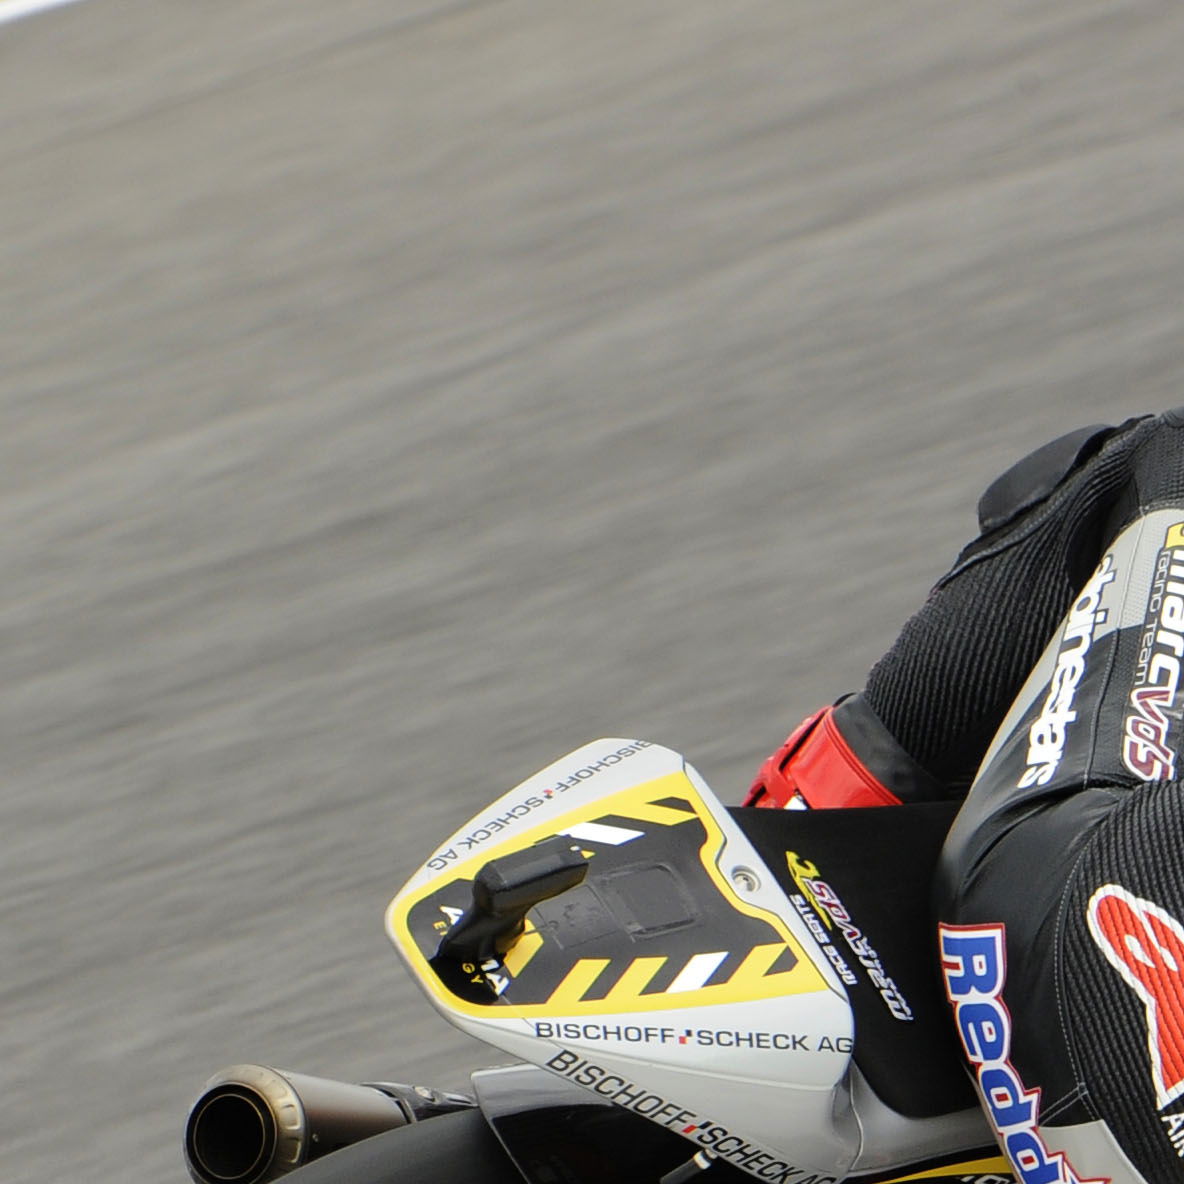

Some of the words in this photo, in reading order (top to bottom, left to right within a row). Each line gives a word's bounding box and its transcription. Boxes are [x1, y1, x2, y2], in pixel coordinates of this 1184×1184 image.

[458, 792, 541, 850] SCHECK
[427, 846, 459, 872] AG
[536, 1021, 675, 1045] BISCHOFF
[697, 1030, 810, 1052] SCHECK
[817, 1036, 853, 1054] AG
[546, 1050, 691, 1130] BISCHOFF
